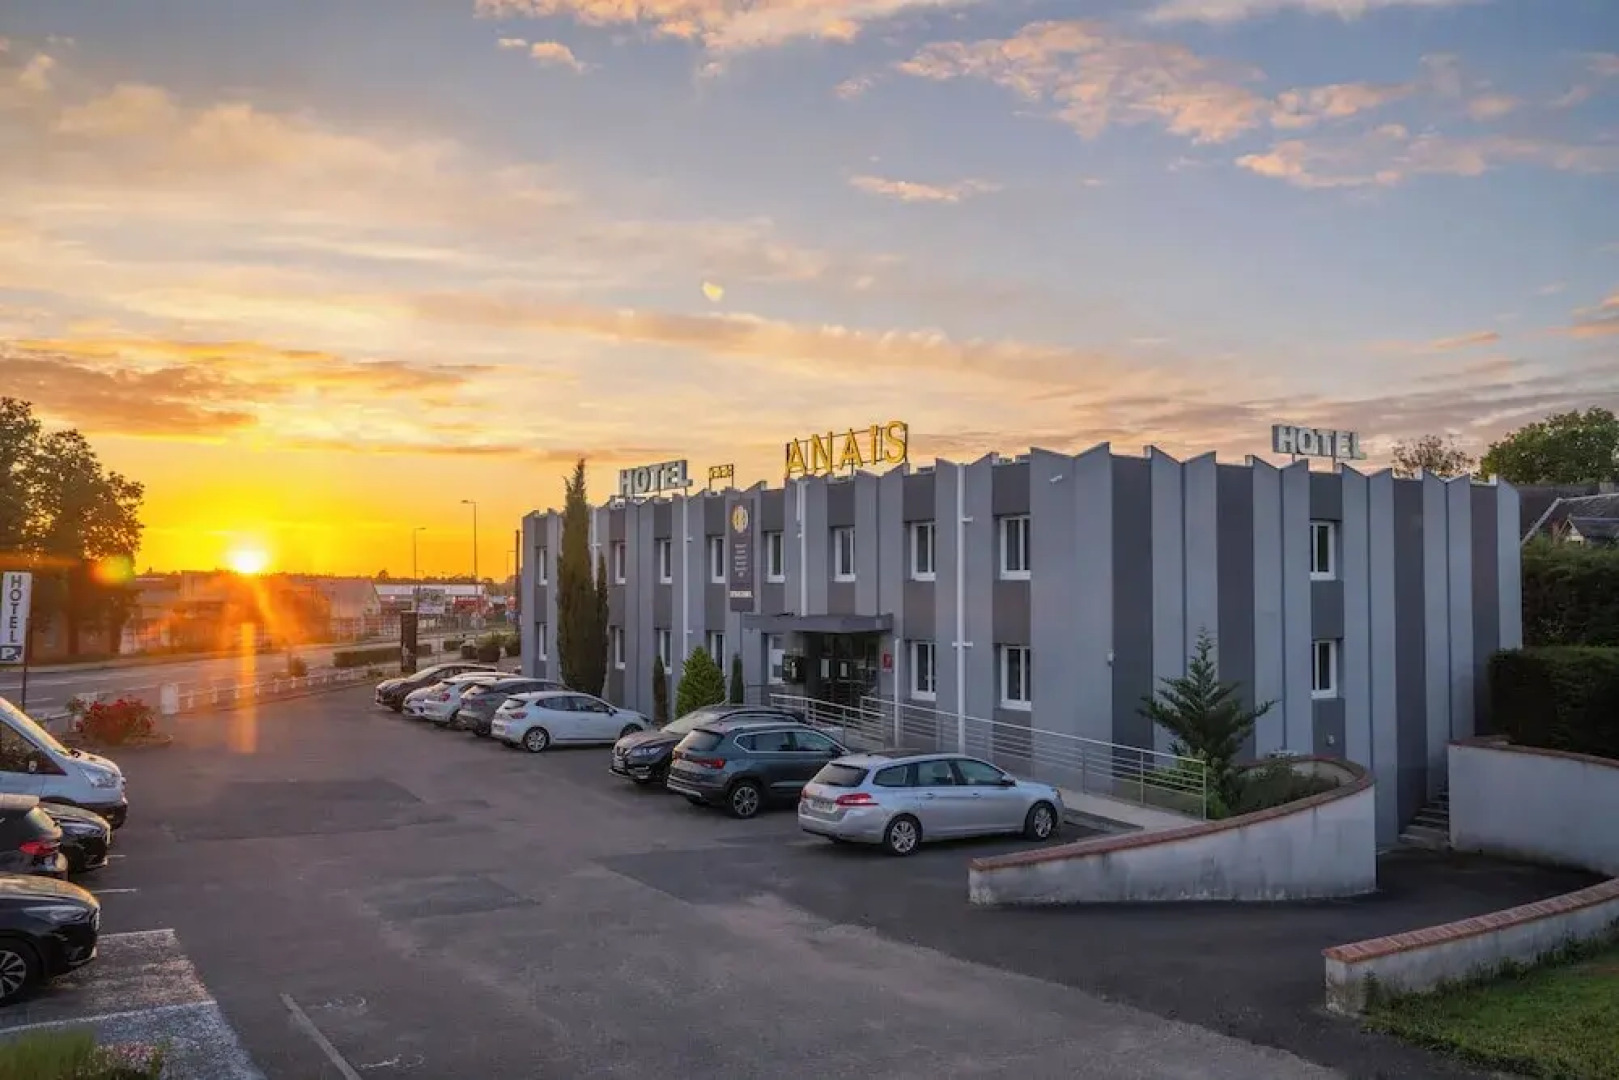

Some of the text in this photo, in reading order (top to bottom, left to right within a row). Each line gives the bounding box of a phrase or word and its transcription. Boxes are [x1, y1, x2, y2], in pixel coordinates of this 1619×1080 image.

[1272, 424, 1367, 460] HOTEL
[620, 460, 693, 495] HOTEL
[9, 575, 22, 643] HOTEL
[1, 647, 16, 660] P
